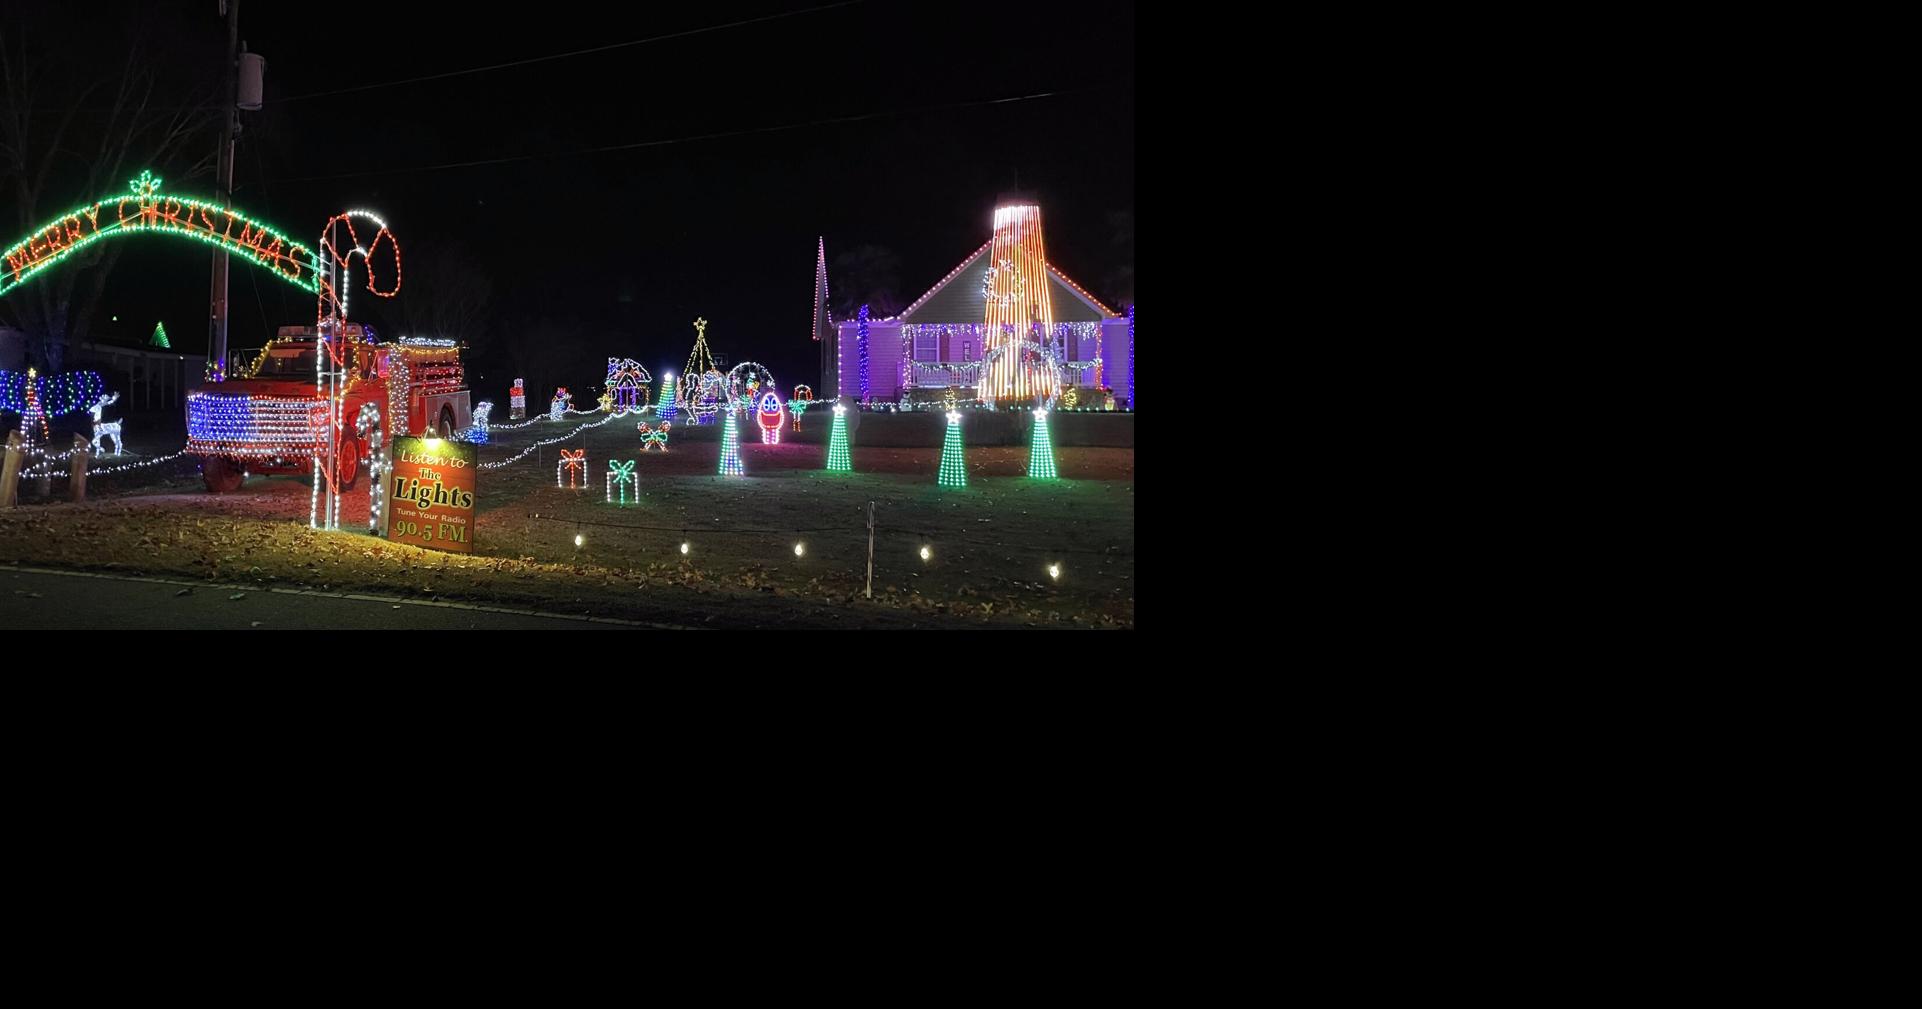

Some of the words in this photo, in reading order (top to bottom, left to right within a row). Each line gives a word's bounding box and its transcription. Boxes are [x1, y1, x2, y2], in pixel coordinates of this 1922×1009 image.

[6, 205, 101, 282] MERRY
[119, 196, 306, 279] CHRISTMAS
[401, 450, 449, 466] Listen
[450, 456, 469, 469] to
[419, 468, 441, 481] The
[394, 477, 472, 509] Lights
[397, 507, 416, 517] Tune
[419, 511, 438, 520] Your
[442, 514, 466, 524] Radio
[396, 520, 433, 541] 90.5
